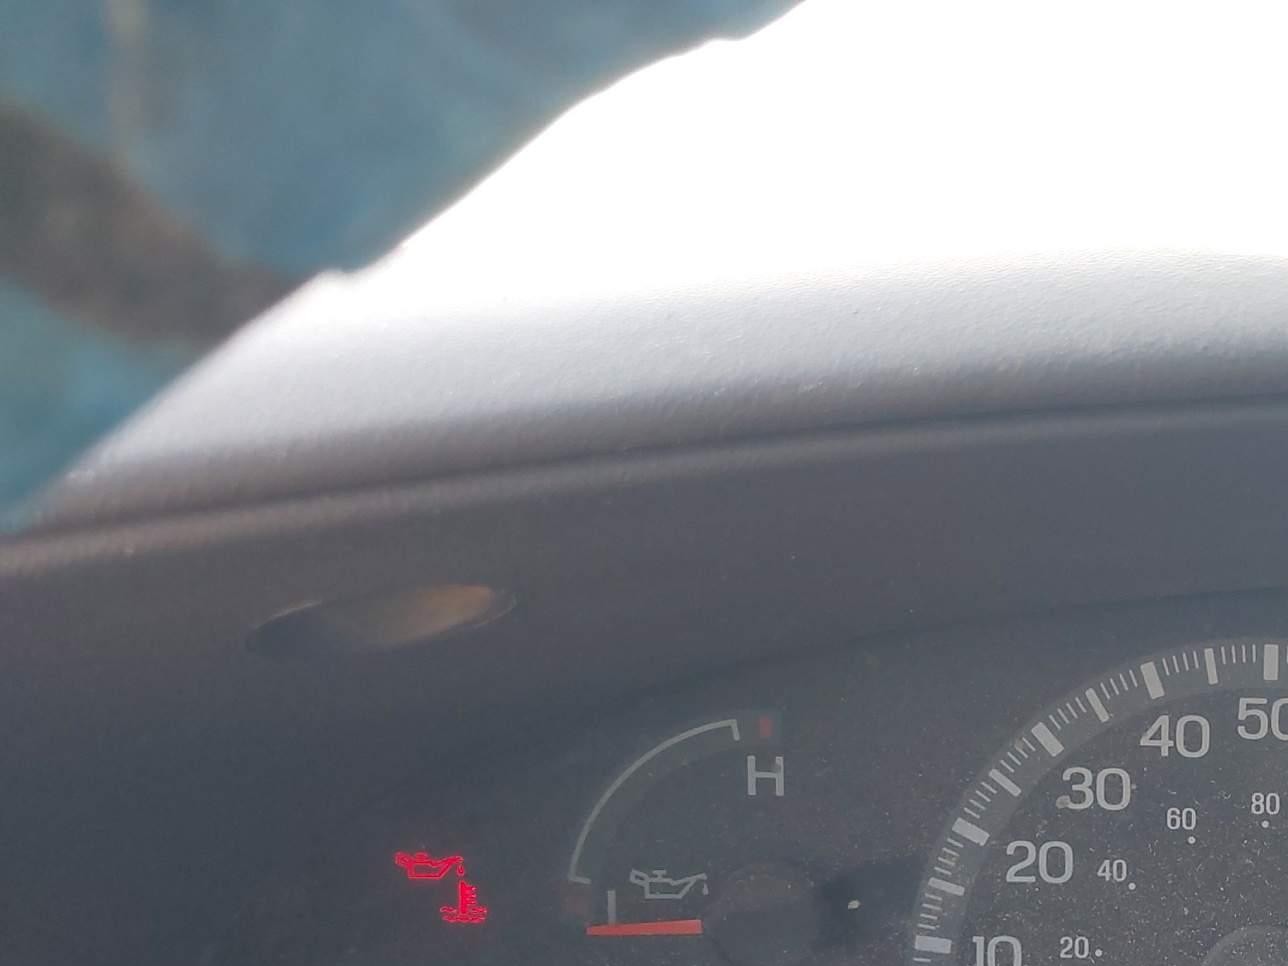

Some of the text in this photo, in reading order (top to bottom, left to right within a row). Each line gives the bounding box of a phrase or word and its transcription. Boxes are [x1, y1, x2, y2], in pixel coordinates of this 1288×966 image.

[1139, 715, 1210, 758] 40
[747, 755, 784, 796] H
[1059, 766, 1131, 811] 30
[1166, 807, 1197, 830] 60
[1251, 793, 1280, 815] 80
[1005, 840, 1074, 883] 20
[1097, 859, 1127, 881] 40
[1059, 936, 1089, 958] 20
